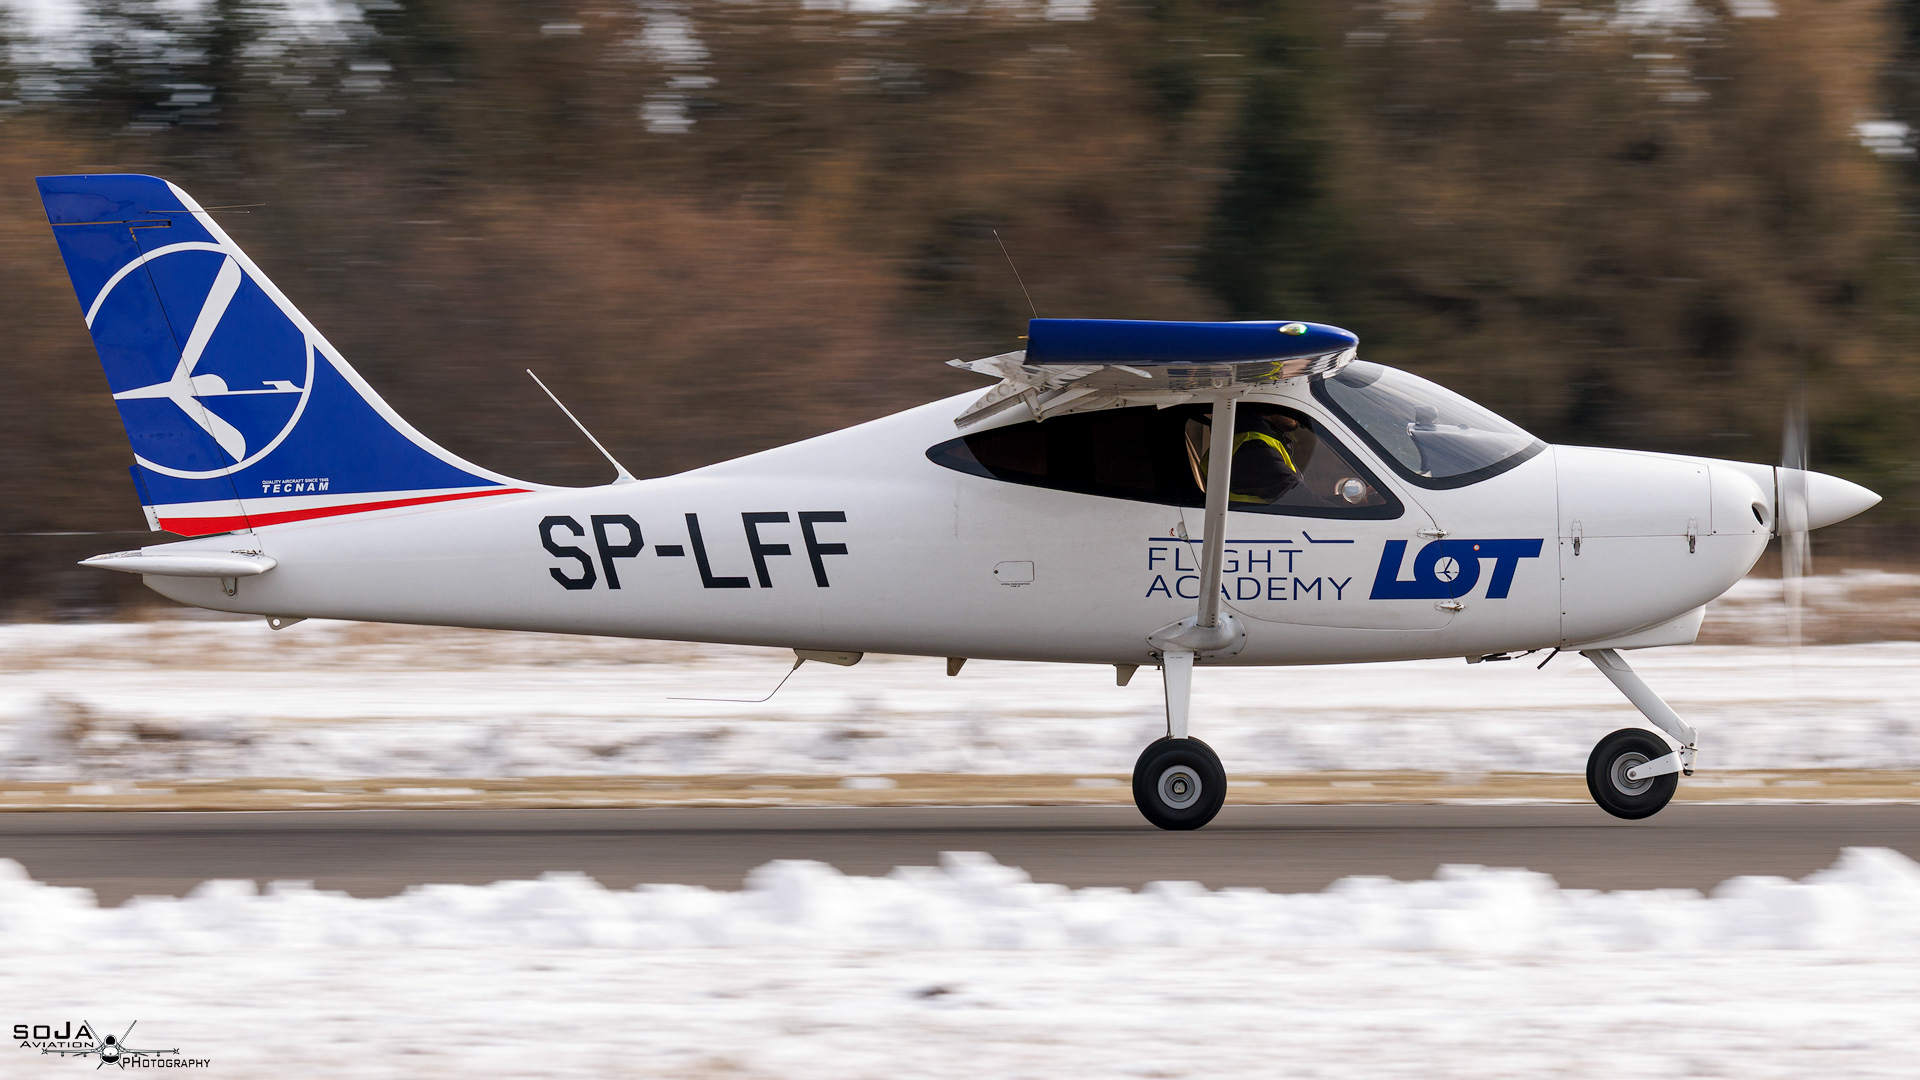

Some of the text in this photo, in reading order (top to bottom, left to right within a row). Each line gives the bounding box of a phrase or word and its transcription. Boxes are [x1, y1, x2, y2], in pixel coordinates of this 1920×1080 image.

[262, 482, 329, 493] TECNAM
[538, 511, 849, 590] SP-LFF
[1148, 547, 1303, 573] FLGHT
[1369, 538, 1544, 600] LOT
